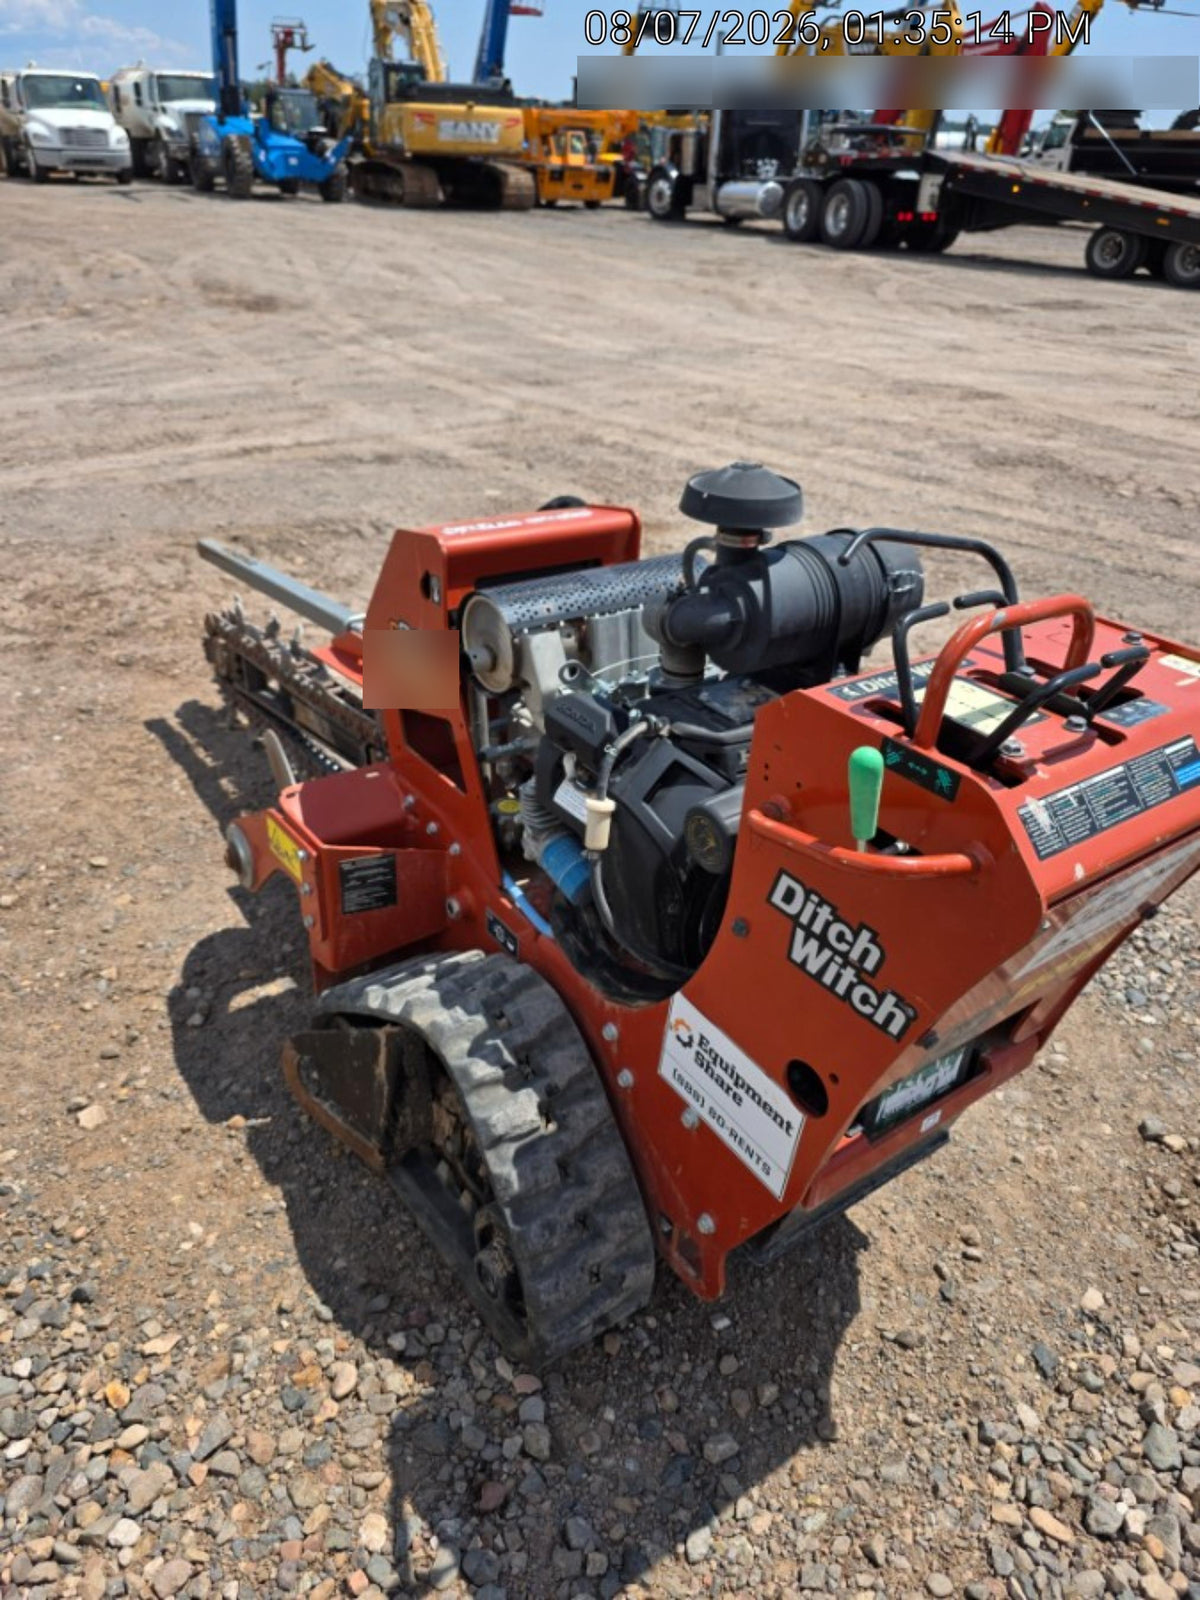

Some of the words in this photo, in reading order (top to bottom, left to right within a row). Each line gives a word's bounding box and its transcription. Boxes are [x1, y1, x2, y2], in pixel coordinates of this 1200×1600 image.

[769, 872, 882, 974] Ditch
[789, 926, 908, 1037] Witch
[694, 1050, 744, 1108] Share
[697, 1031, 795, 1138] Equipment
